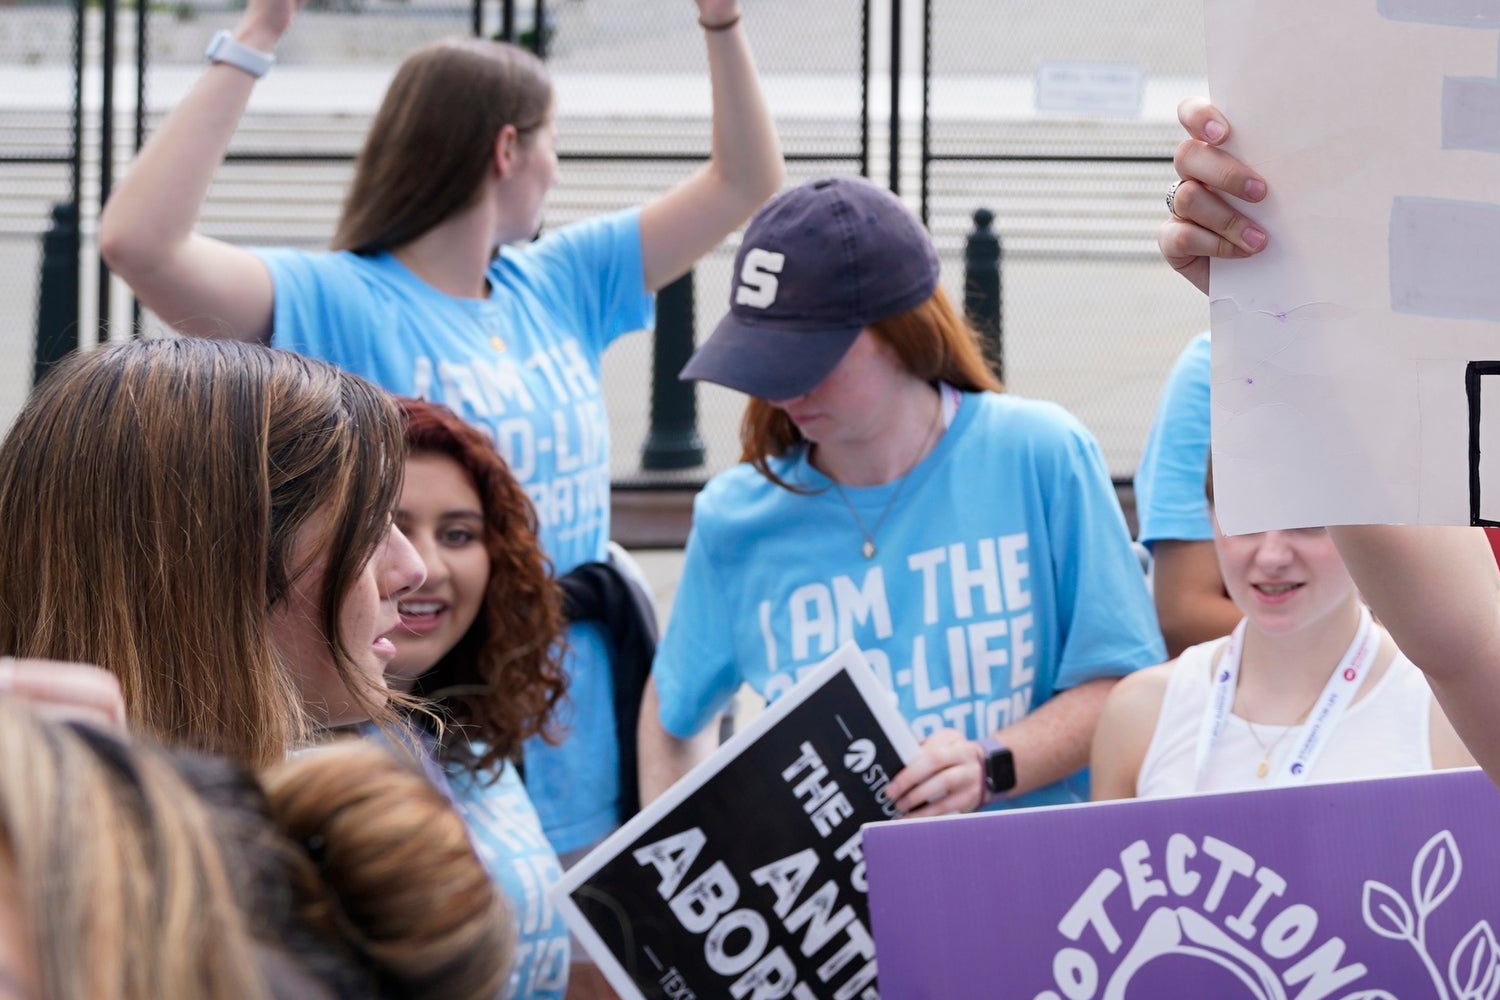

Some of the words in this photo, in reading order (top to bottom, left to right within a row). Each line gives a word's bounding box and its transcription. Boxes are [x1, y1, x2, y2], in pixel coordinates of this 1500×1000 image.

[736, 248, 785, 309] S
[759, 599, 778, 673] I
[789, 565, 894, 662] AM
[907, 532, 1032, 626] THE
[782, 740, 854, 838] THE
[1032, 833, 1368, 1000] OTECTION
